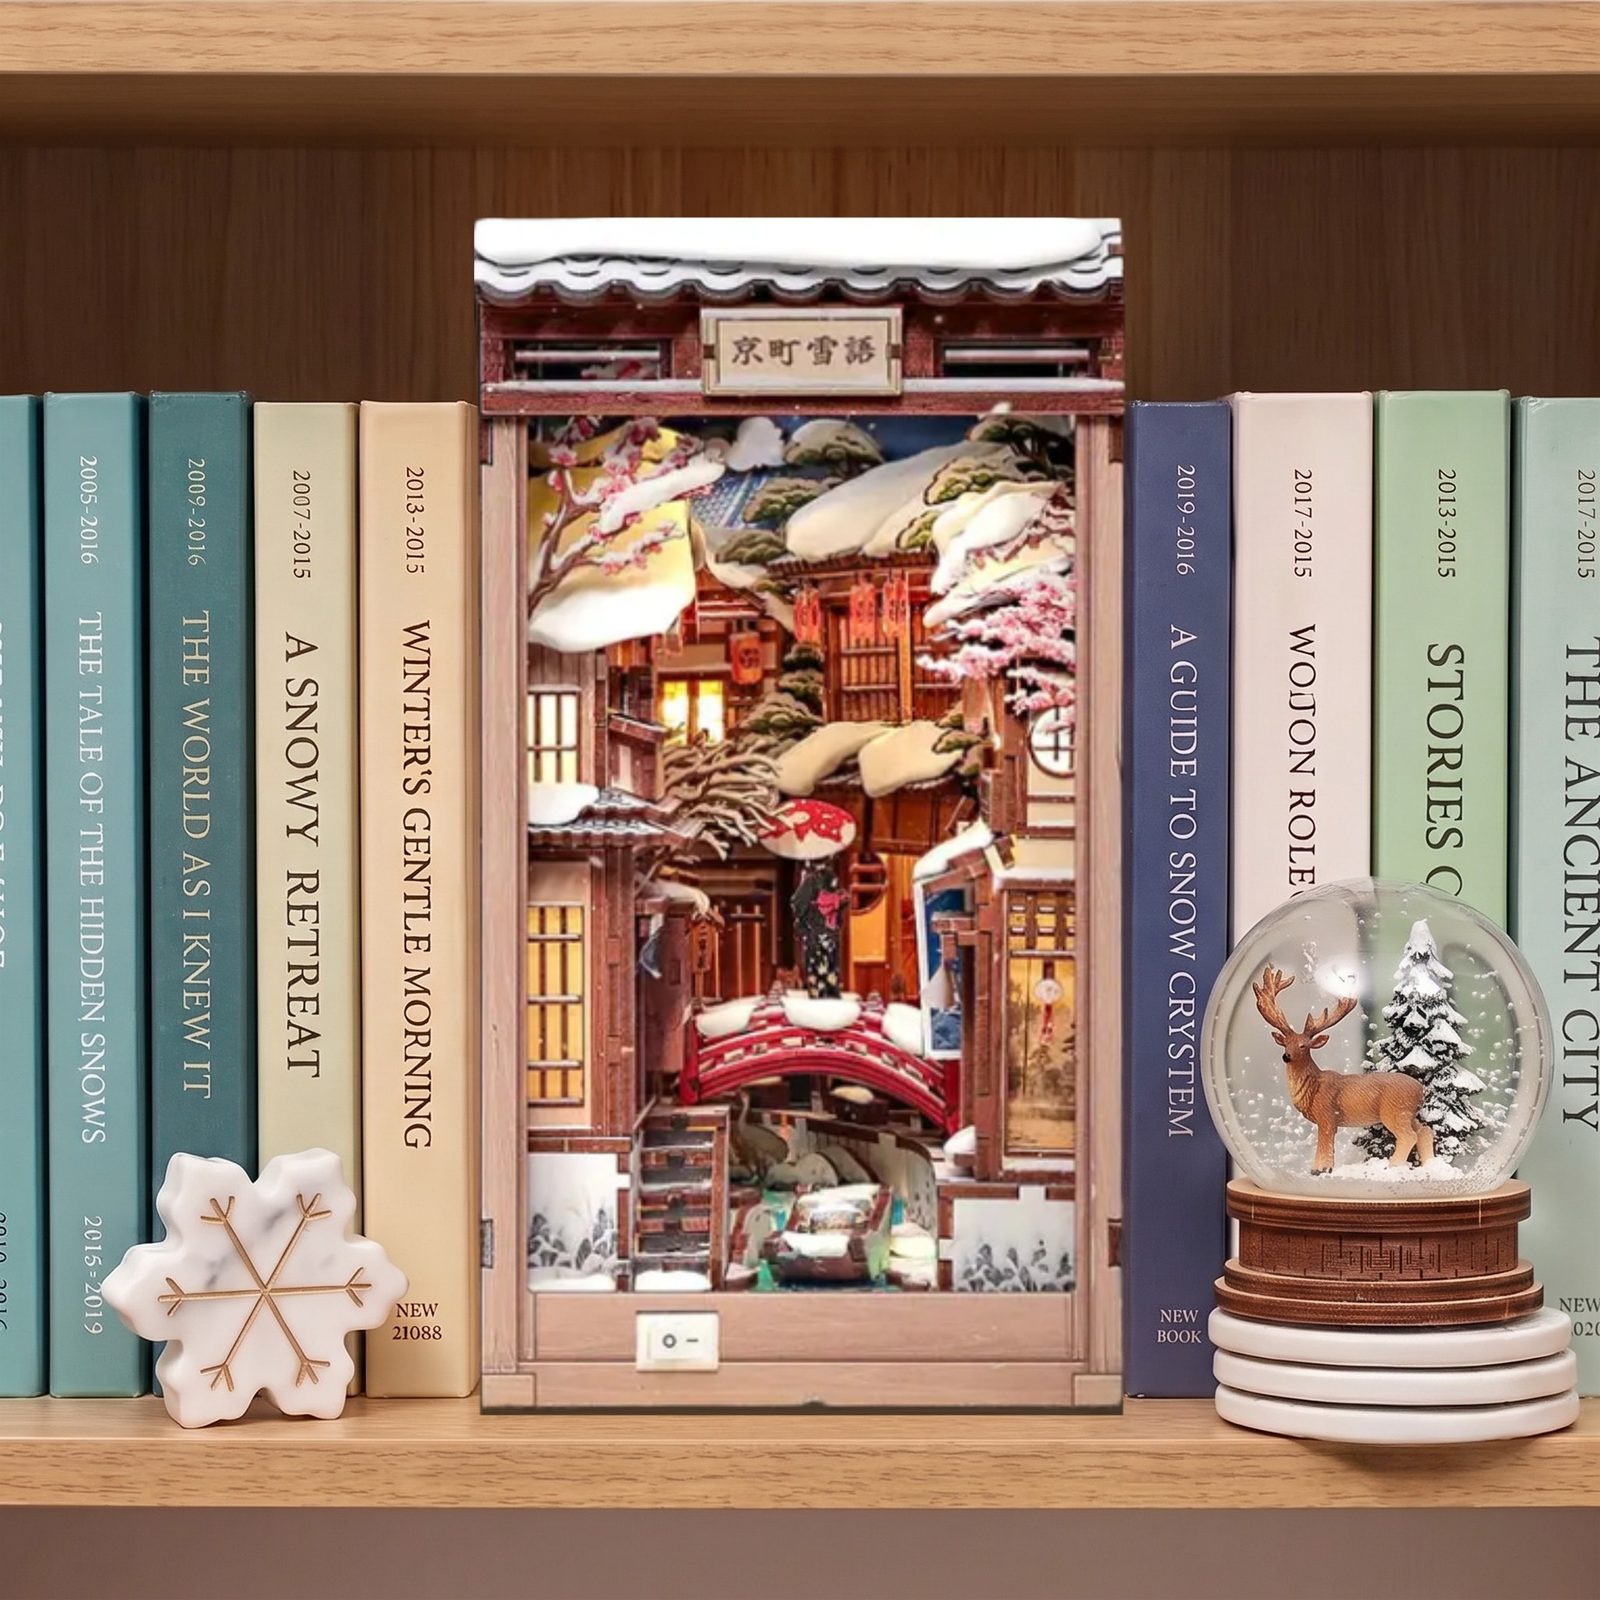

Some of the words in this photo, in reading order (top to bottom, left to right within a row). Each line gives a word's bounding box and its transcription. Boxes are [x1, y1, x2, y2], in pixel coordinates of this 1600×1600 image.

[732, 335, 876, 367] 京町雪語
[80, 455, 99, 565] 2005-2016
[187, 458, 206, 567] 2009-2016
[292, 469, 311, 580] 2007-2015
[405, 466, 425, 575] 2013-2015
[1176, 464, 1196, 577] 2019-2016
[1294, 468, 1313, 579] 2017-2015
[1437, 468, 1457, 579] 2013-2015
[1577, 469, 1596, 580] 2017-2015
[78, 611, 103, 676] THE
[182, 609, 210, 687] THE
[285, 631, 319, 663] A
[1169, 624, 1198, 650] A
[1564, 635, 1600, 742] THE
[79, 684, 103, 763] TALE
[285, 677, 320, 848] SNOWY
[402, 619, 432, 796] WINTER'S
[1169, 660, 1198, 779] GUIDE
[1425, 643, 1465, 850] STORIES
[79, 771, 103, 815] OF
[182, 697, 211, 839] WORLD
[1168, 787, 1198, 840] TO
[79, 822, 104, 887] THE
[182, 850, 211, 897] AS
[402, 807, 432, 955] GENTLE
[1288, 788, 1317, 899] ROLE
[1563, 754, 1600, 993] ANCIENT
[79, 895, 105, 1022] HIDDEN
[182, 908, 211, 921] I
[1168, 851, 1198, 962] SNOW
[182, 932, 211, 1050] KNEW
[286, 868, 321, 1079] RETREAT
[79, 1032, 106, 1144] SNOWS
[183, 1060, 211, 1099] IT
[403, 965, 432, 1150] MORNING
[1167, 970, 1197, 1138] CRYSTEM
[1562, 1008, 1600, 1133] CITY
[391, 1325, 443, 1341] 21088
[395, 1302, 439, 1319] NEW
[1156, 1329, 1202, 1344] BOOK
[1160, 1308, 1199, 1323] NEW
[1559, 1297, 1600, 1313] NEW
